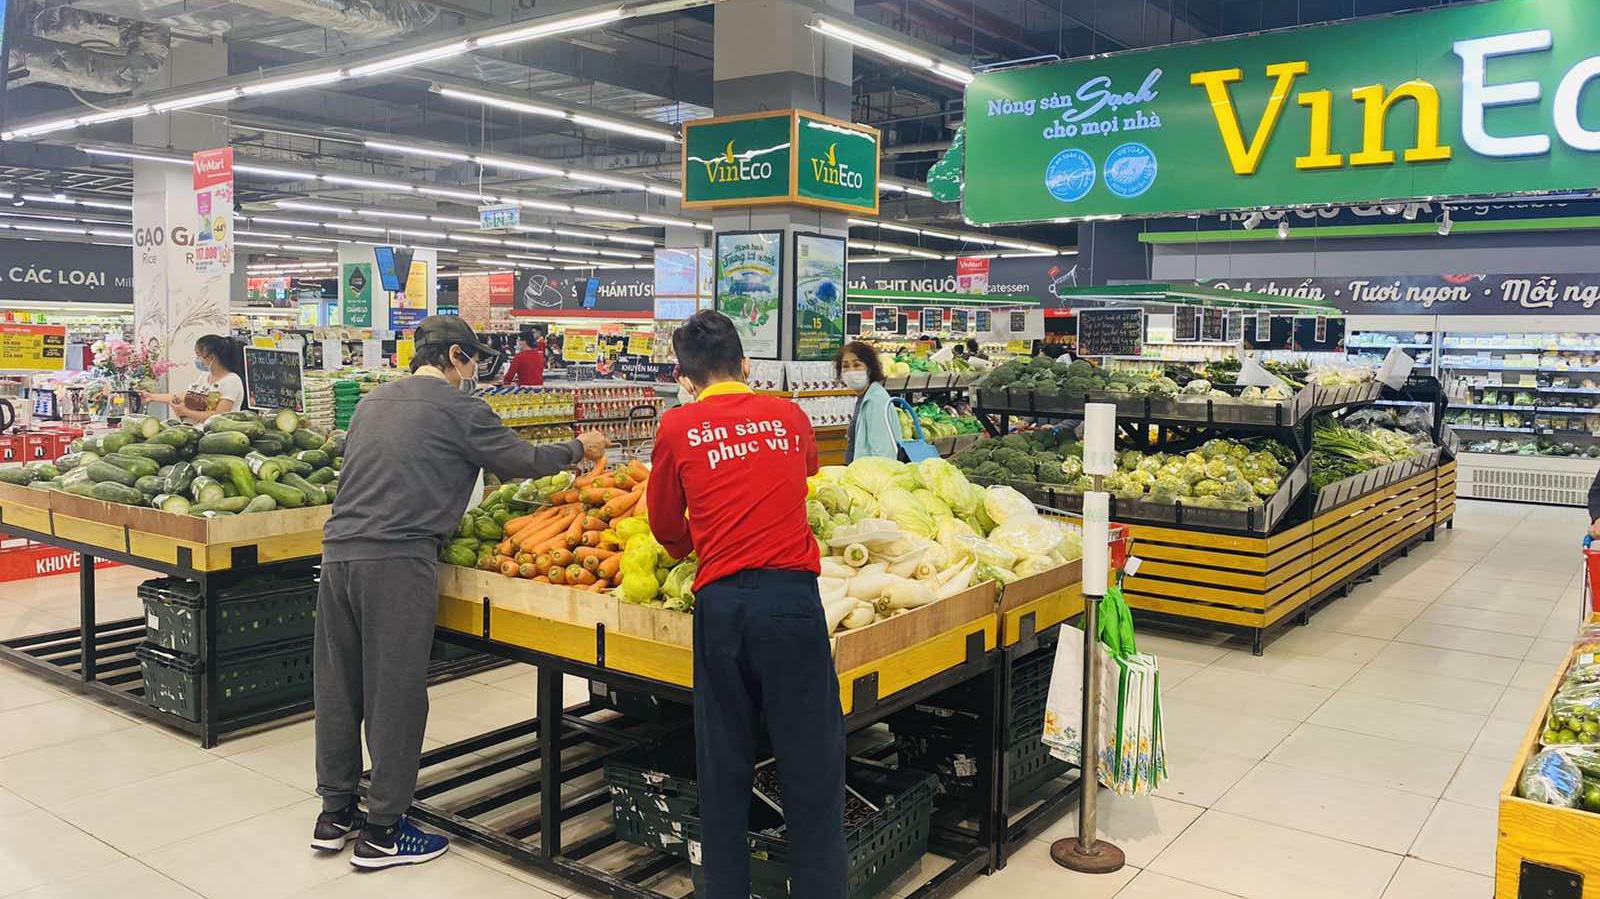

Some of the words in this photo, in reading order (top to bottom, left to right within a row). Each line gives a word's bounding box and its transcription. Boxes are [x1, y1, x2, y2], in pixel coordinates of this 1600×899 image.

[987, 98, 1036, 116] Nông
[1040, 92, 1072, 110] sản
[1062, 68, 1163, 122] Sạch
[1190, 28, 1600, 176] VinEc
[1043, 119, 1078, 139] cho
[1081, 116, 1119, 136] mọi
[1123, 110, 1162, 131] nhà
[195, 157, 225, 175] VinMart
[704, 158, 772, 183] VinEco
[811, 157, 863, 189] VinEco
[135, 226, 164, 251] GẠO
[8, 264, 53, 284] CÁC
[58, 269, 105, 290] LOẠI
[1348, 280, 1402, 301] Tươi
[1405, 285, 1471, 308] ngon
[1501, 276, 1559, 308] Mỗi
[1563, 285, 1600, 308] ng
[812, 317, 822, 329] 15
[687, 421, 728, 447] Sẵn
[735, 418, 787, 437] sàng
[707, 440, 759, 470] phục
[765, 438, 790, 455] vụ
